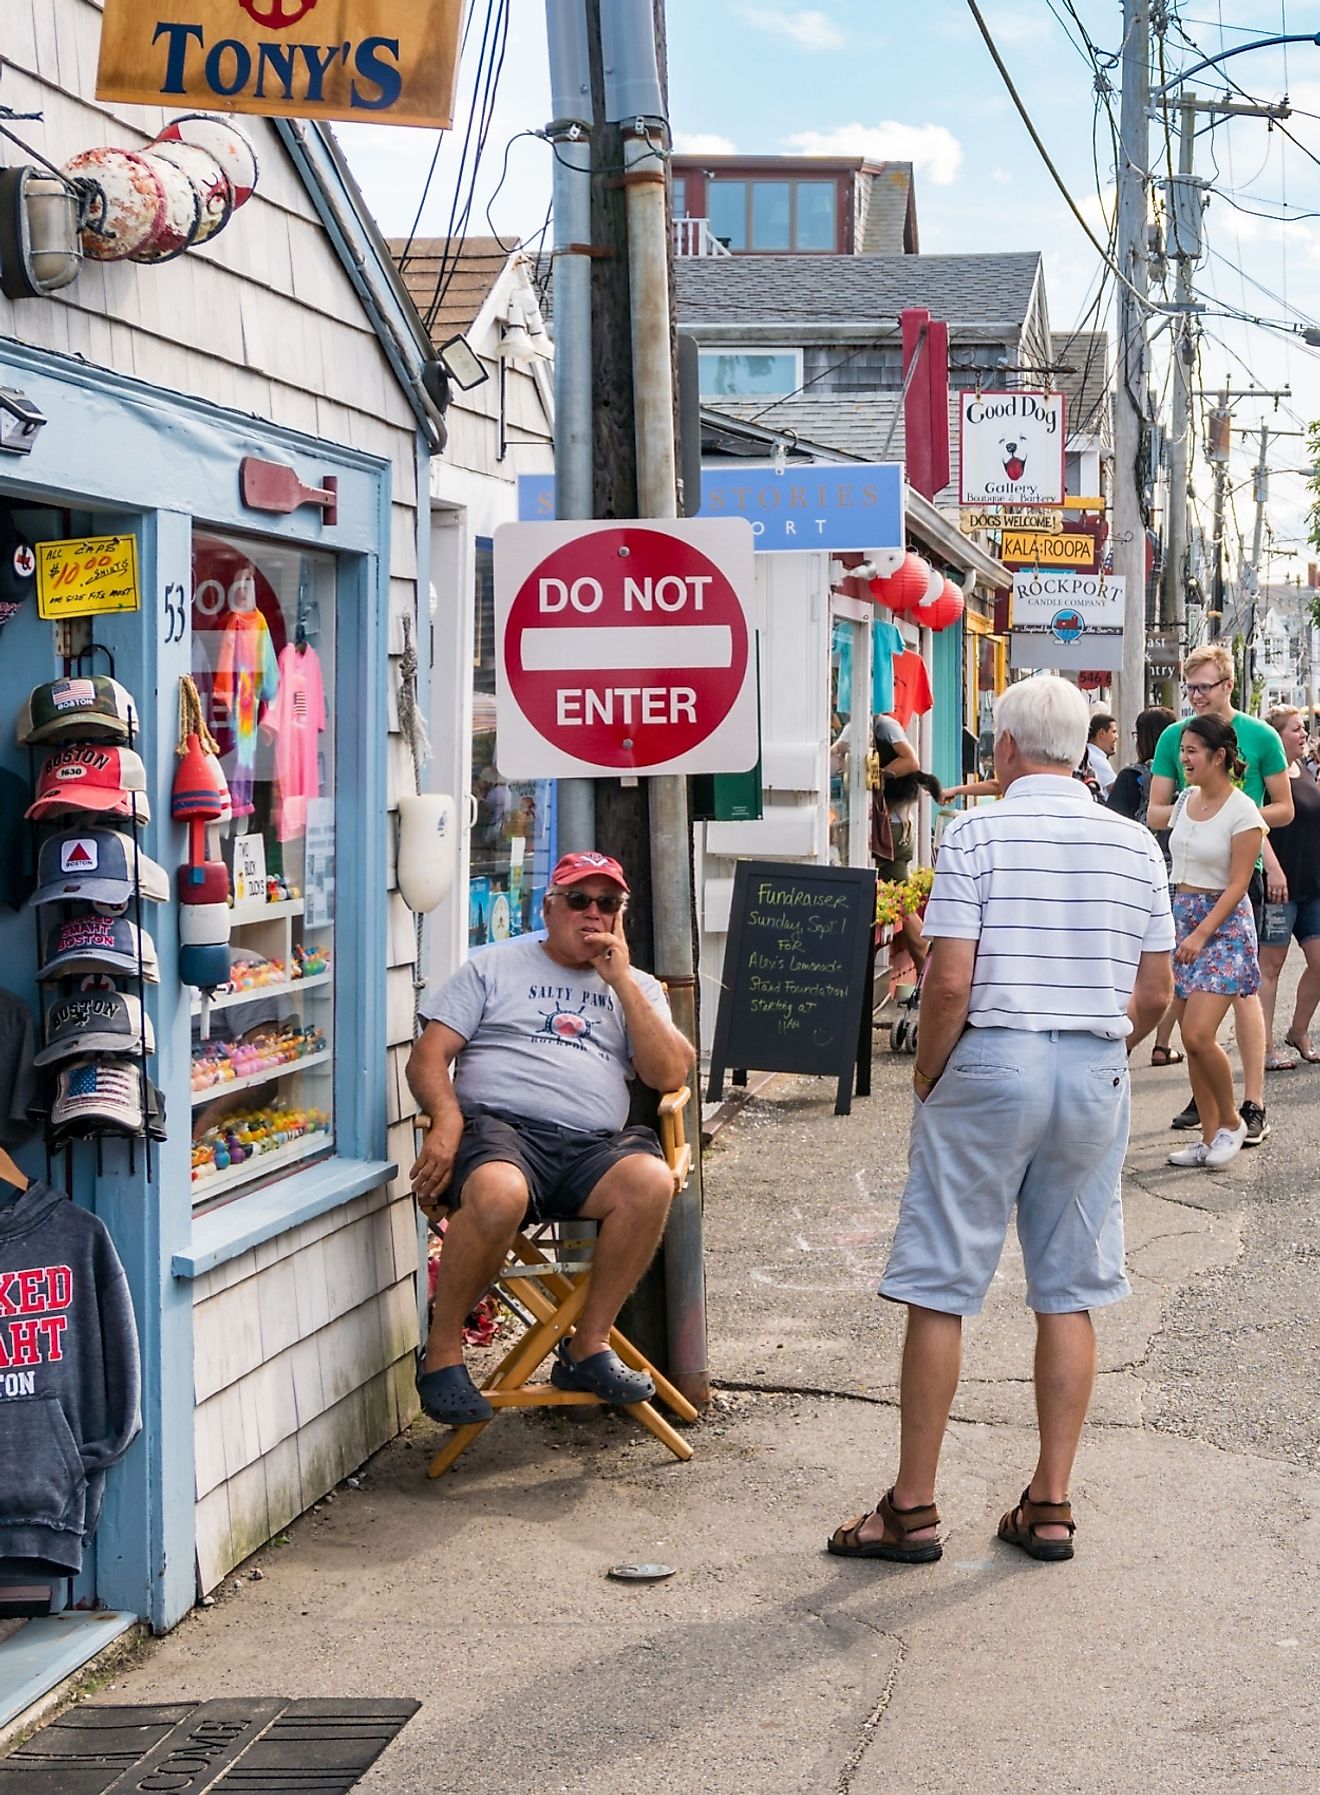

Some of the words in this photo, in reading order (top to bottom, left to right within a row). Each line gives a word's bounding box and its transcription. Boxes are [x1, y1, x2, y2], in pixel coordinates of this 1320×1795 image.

[151, 22, 402, 110] TONY'S
[966, 396, 1017, 424] Good
[1021, 396, 1057, 433] Dog
[707, 482, 880, 511] STORIES
[985, 481, 1038, 495] Gallery
[970, 514, 1002, 527] DOGS
[1003, 514, 1057, 530] WELCOME!
[46, 548, 63, 561] ALL
[74, 541, 117, 555] CAPS
[538, 576, 604, 614] DO
[624, 575, 713, 612] NOT
[1016, 578, 1123, 602] ROCKPORT
[164, 581, 186, 644] 53
[1027, 598, 1062, 607] CANDLE
[1064, 598, 1107, 608] COMPANY
[57, 698, 94, 711] BOSTON
[556, 686, 698, 726] ENTER
[45, 748, 112, 775] BOSTON
[61, 767, 82, 777] 1630
[56, 934, 115, 952] BOSTON
[528, 985, 573, 1000] SALTY
[582, 990, 614, 1012] PAWS
